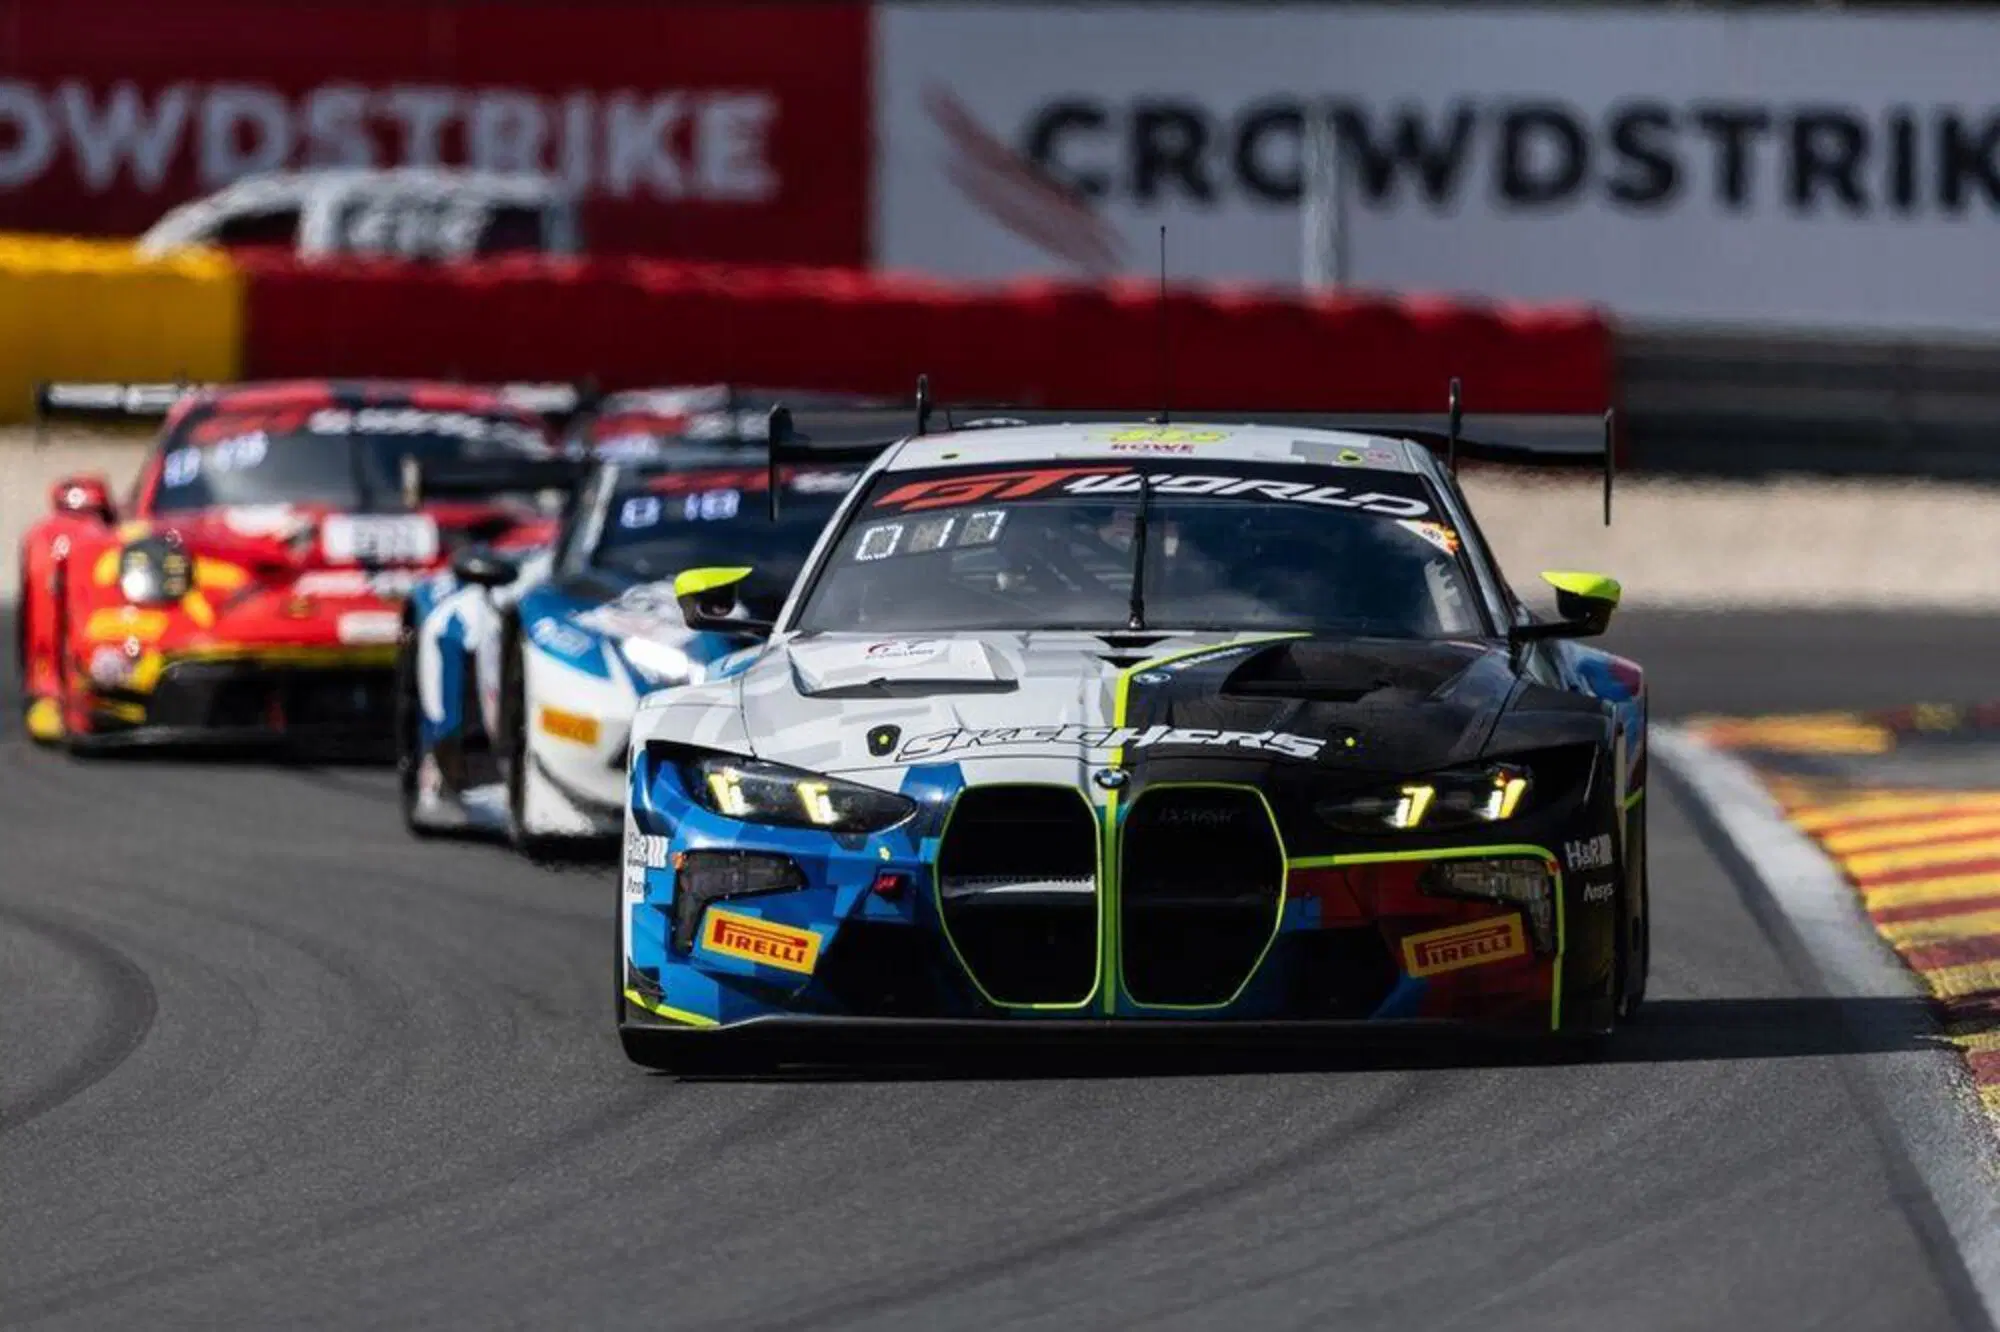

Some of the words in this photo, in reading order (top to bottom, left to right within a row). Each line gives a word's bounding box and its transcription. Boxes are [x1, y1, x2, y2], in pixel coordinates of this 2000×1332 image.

[894, 723, 1327, 761] SKECHERS
[713, 918, 808, 964] PIRELLI
[1414, 923, 1512, 968] PIRELLI
